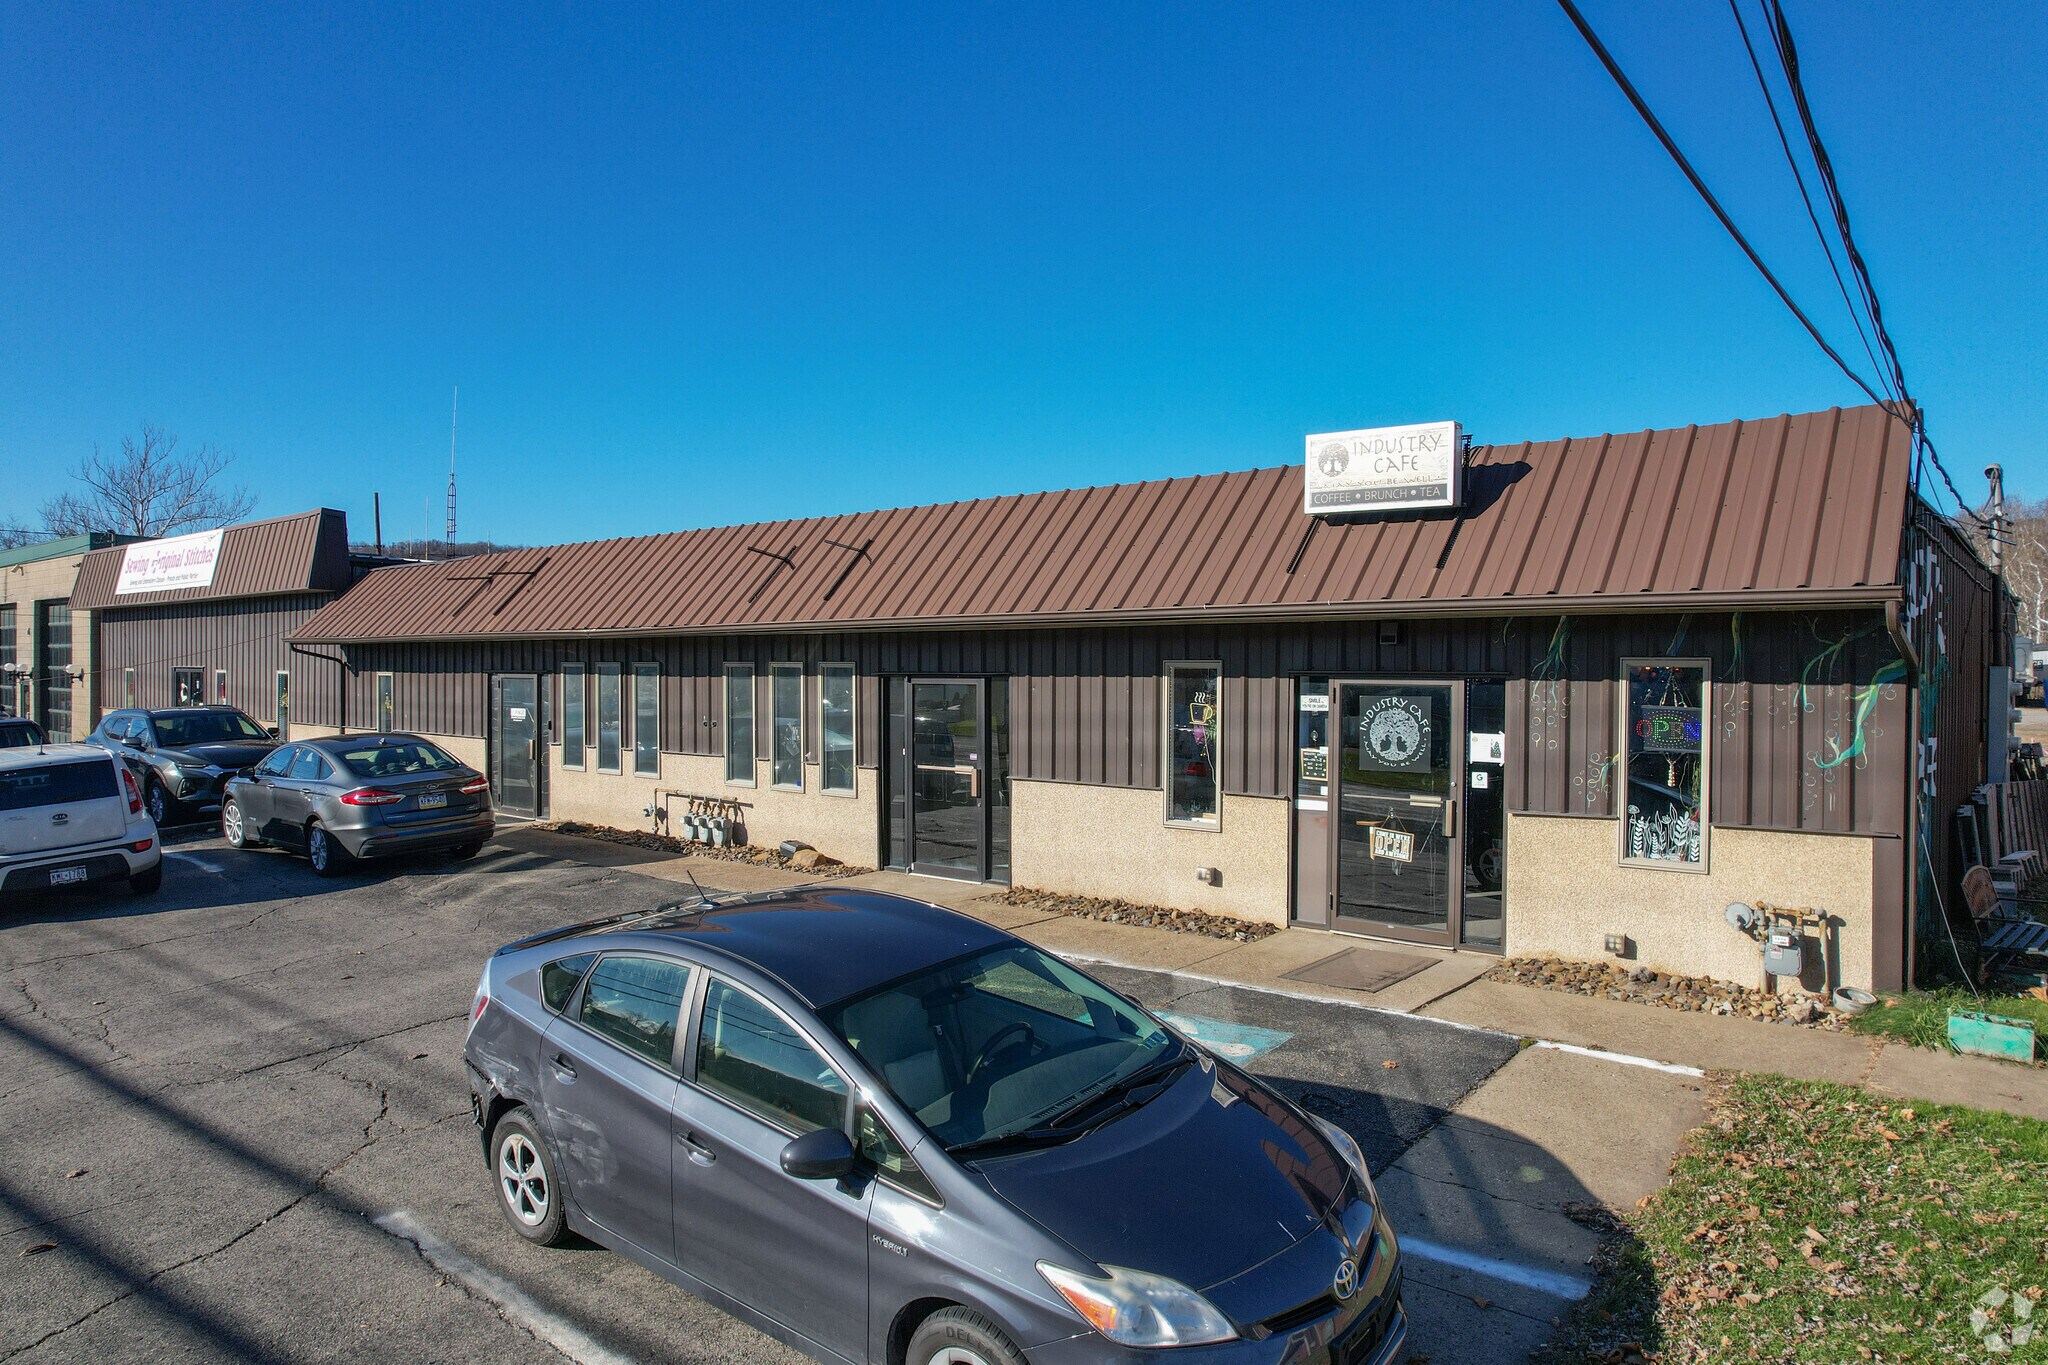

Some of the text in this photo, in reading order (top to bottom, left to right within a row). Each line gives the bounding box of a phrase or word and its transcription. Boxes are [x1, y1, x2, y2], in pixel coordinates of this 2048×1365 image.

[1351, 434, 1442, 457] INDUSTRY
[1374, 455, 1419, 474] CAFE
[1403, 476, 1431, 484] WELL
[1314, 487, 1440, 504] COFFEE BRUNCH TEA
[125, 555, 149, 576] Sewing
[184, 545, 215, 567] Stitches
[1360, 696, 1431, 734] INDUSTRY CAFE
[1635, 718, 1701, 741] OPEN
[1378, 759, 1397, 767] YOU
[1374, 835, 1411, 855] OPEN
[945, 1325, 994, 1360] DELTA
